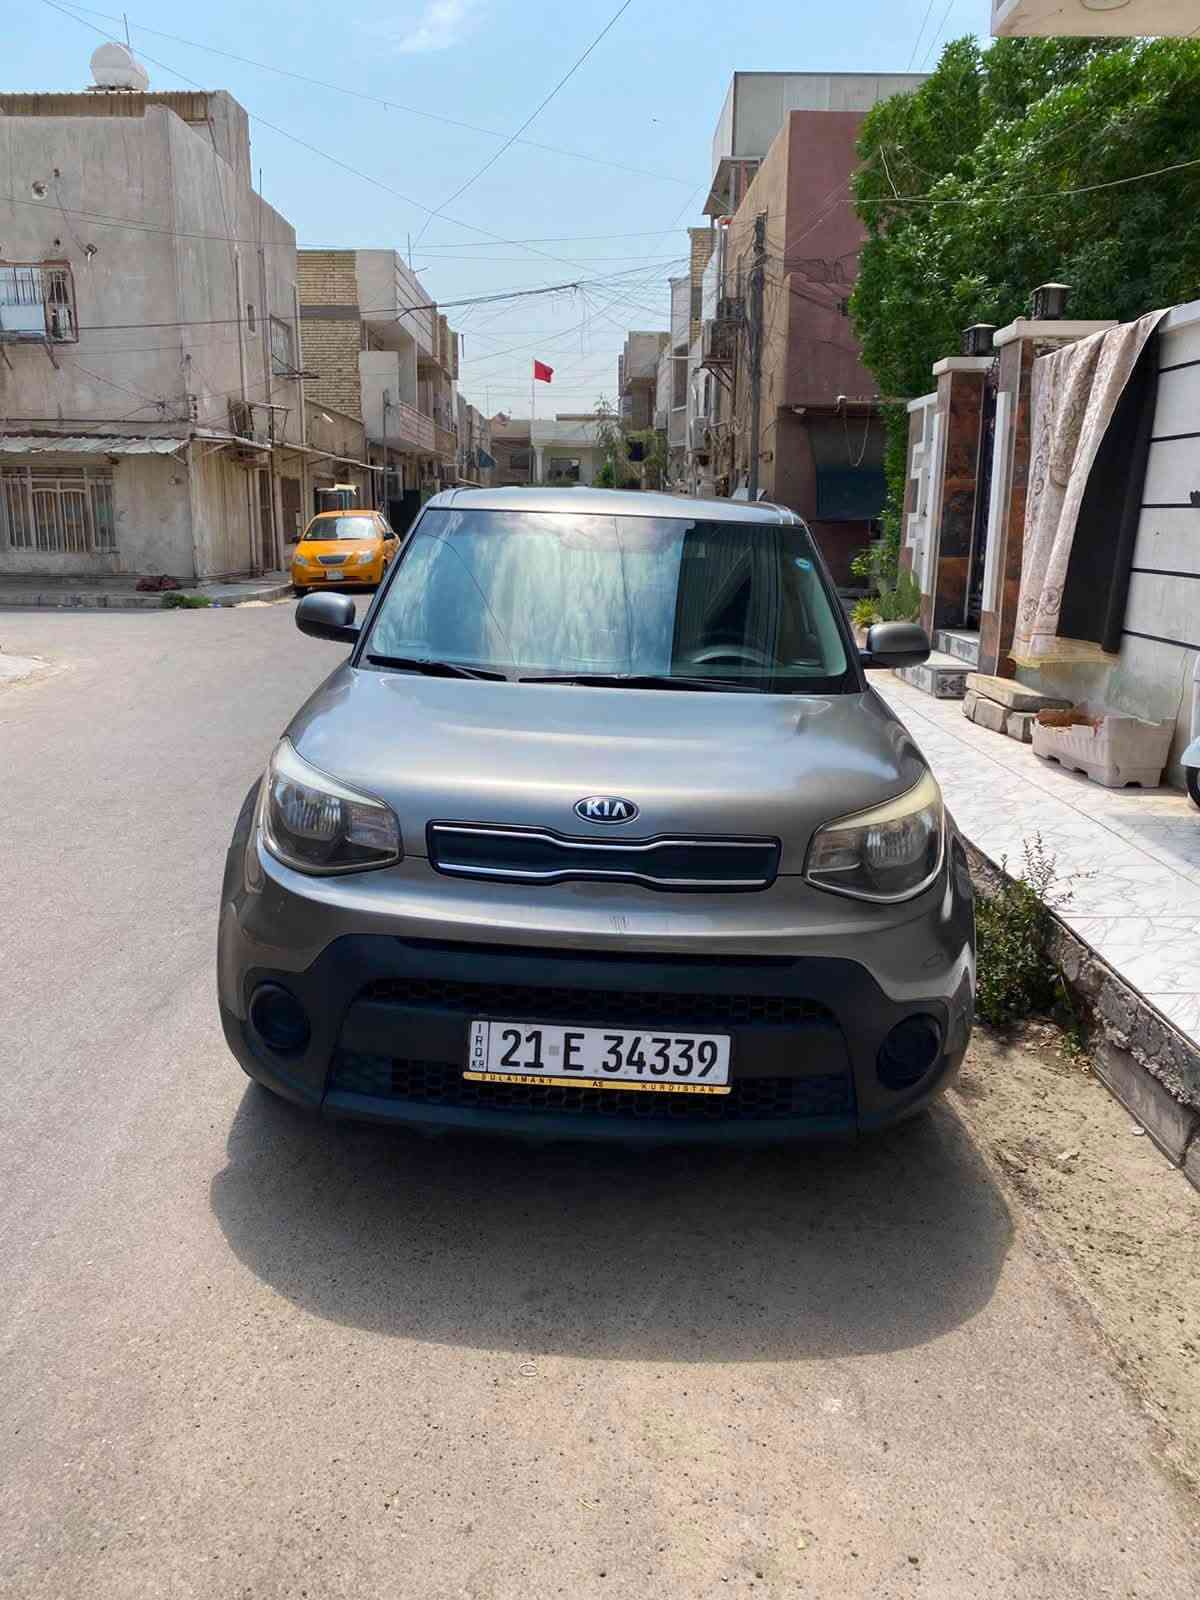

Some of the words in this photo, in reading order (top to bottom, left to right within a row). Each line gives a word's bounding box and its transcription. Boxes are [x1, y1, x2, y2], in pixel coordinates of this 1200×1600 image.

[586, 799, 628, 818] KIA
[500, 1029, 545, 1069] 21
[563, 1032, 585, 1071] E
[602, 1034, 718, 1078] 34339
